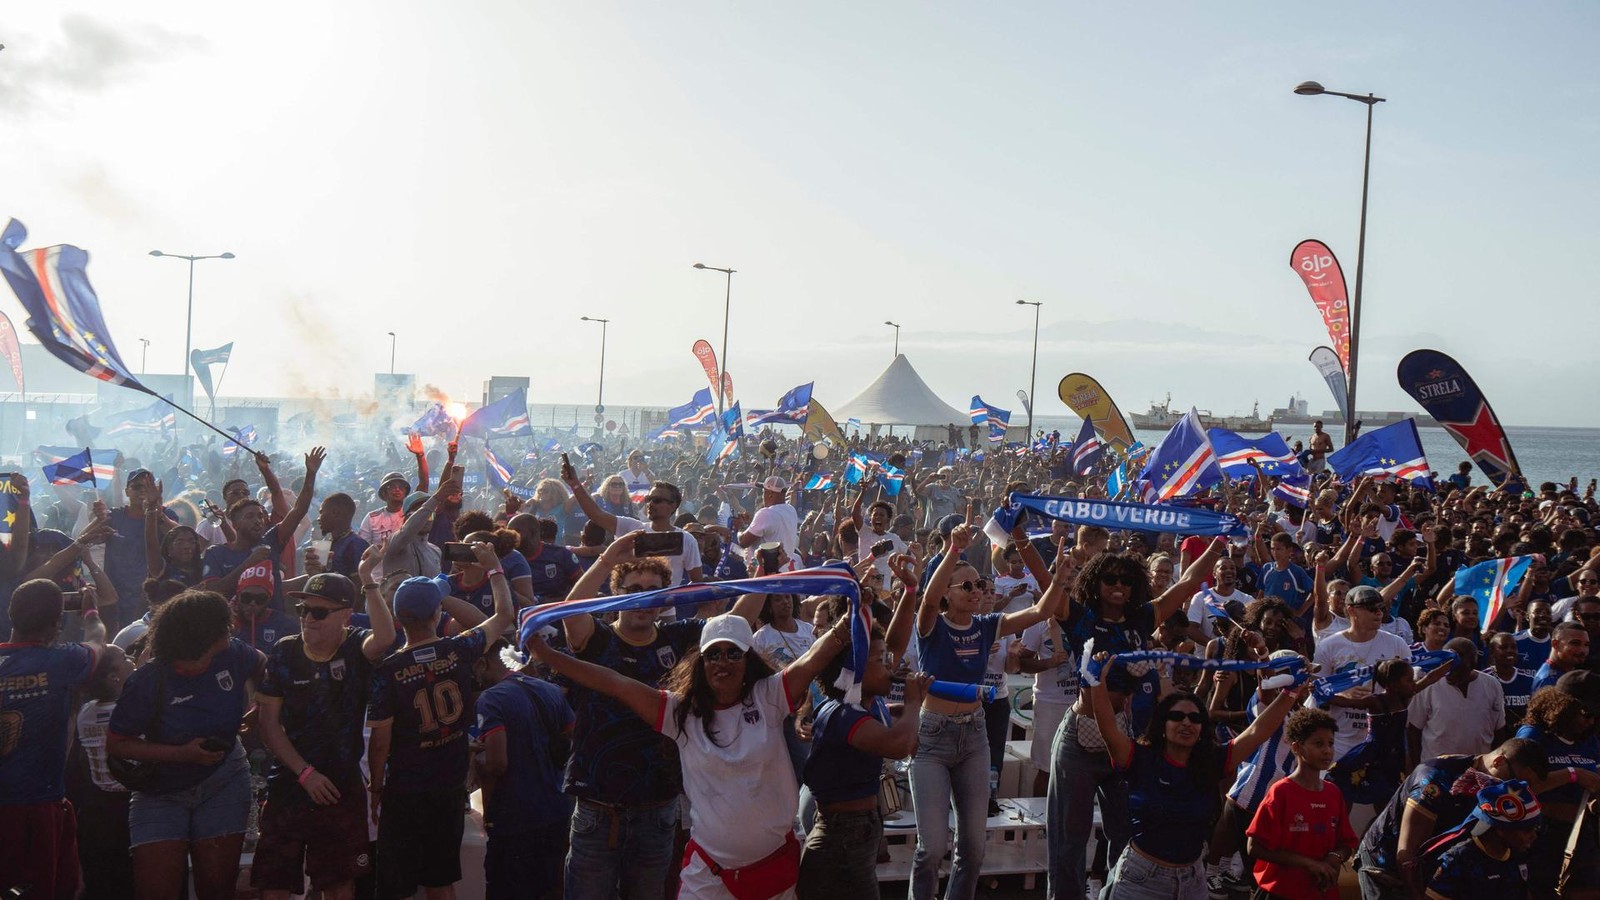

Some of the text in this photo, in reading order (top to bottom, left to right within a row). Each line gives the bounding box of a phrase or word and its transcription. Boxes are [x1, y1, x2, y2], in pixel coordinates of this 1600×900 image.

[1420, 379, 1461, 399] STRELA
[1044, 500, 1191, 528] CABO VERDE
[239, 566, 266, 581] ABO
[413, 680, 464, 732] 10
[1548, 755, 1571, 765] CABO
